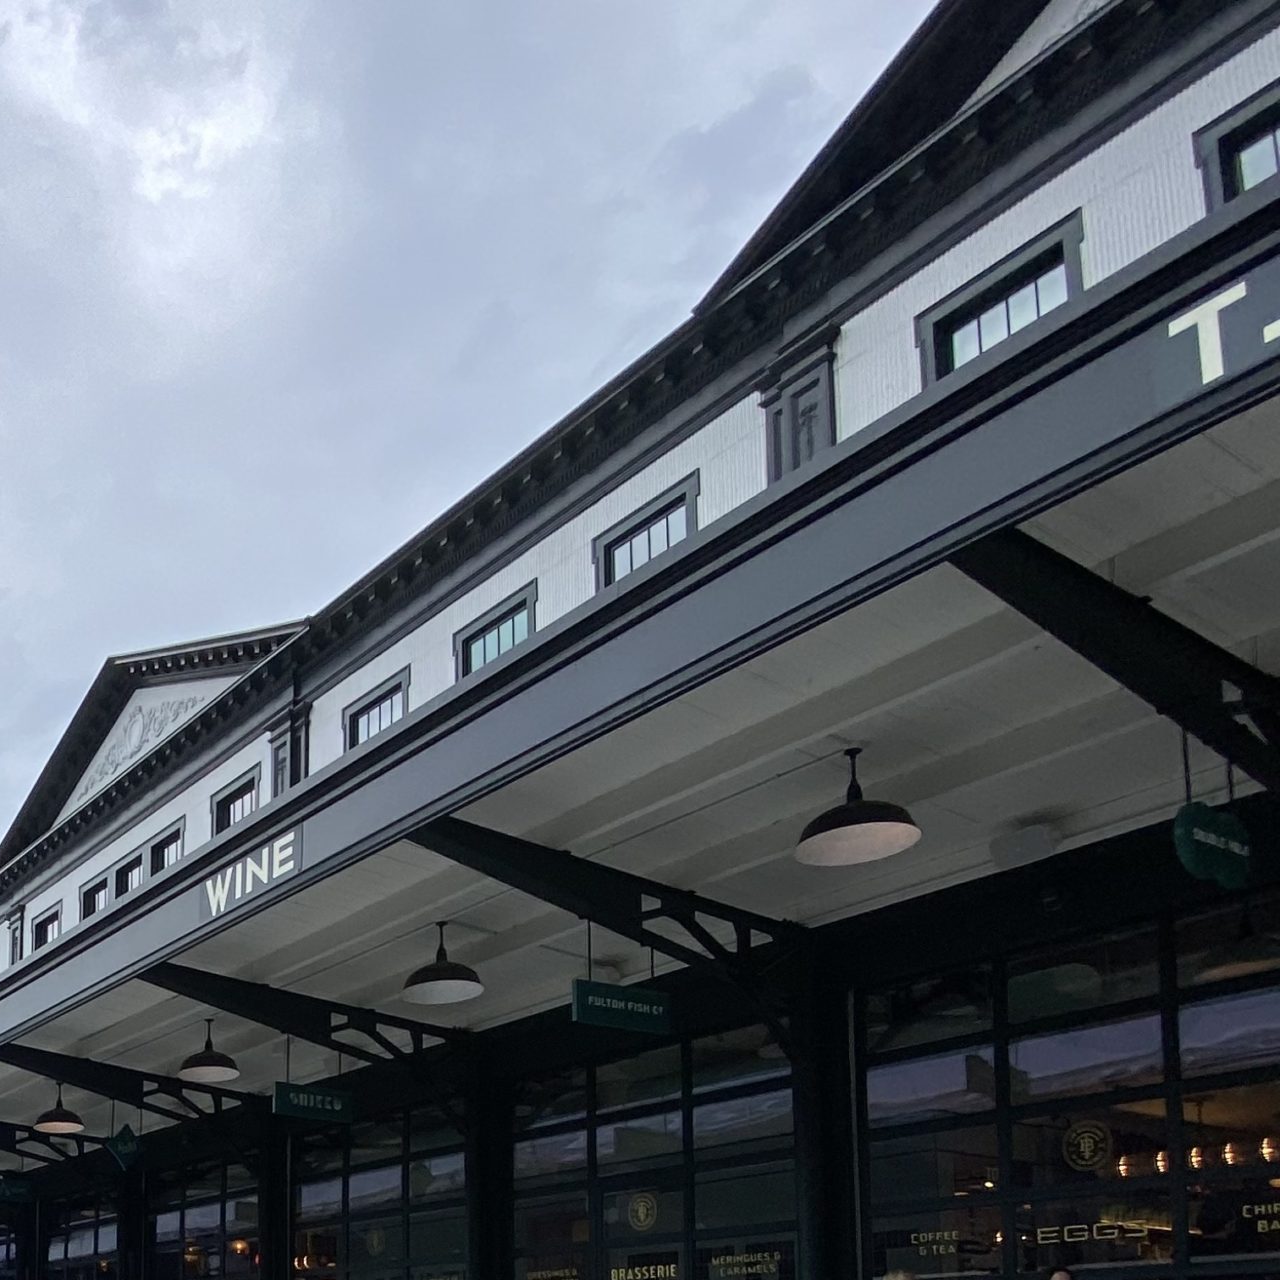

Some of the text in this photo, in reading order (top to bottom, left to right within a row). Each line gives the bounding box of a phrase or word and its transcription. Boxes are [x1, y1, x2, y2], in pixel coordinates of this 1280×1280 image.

[1167, 281, 1280, 385] T
[205, 831, 295, 917] WINE
[588, 995, 625, 1010] FULTON
[627, 1001, 651, 1013] FISH
[910, 1230, 960, 1245] COFFEE
[1037, 1219, 1148, 1245] EGGS
[711, 1252, 770, 1265] MERINGUES
[931, 1244, 956, 1257] TEA
[610, 1264, 678, 1280] BRASSERIE
[720, 1264, 776, 1278] CARAMELS
